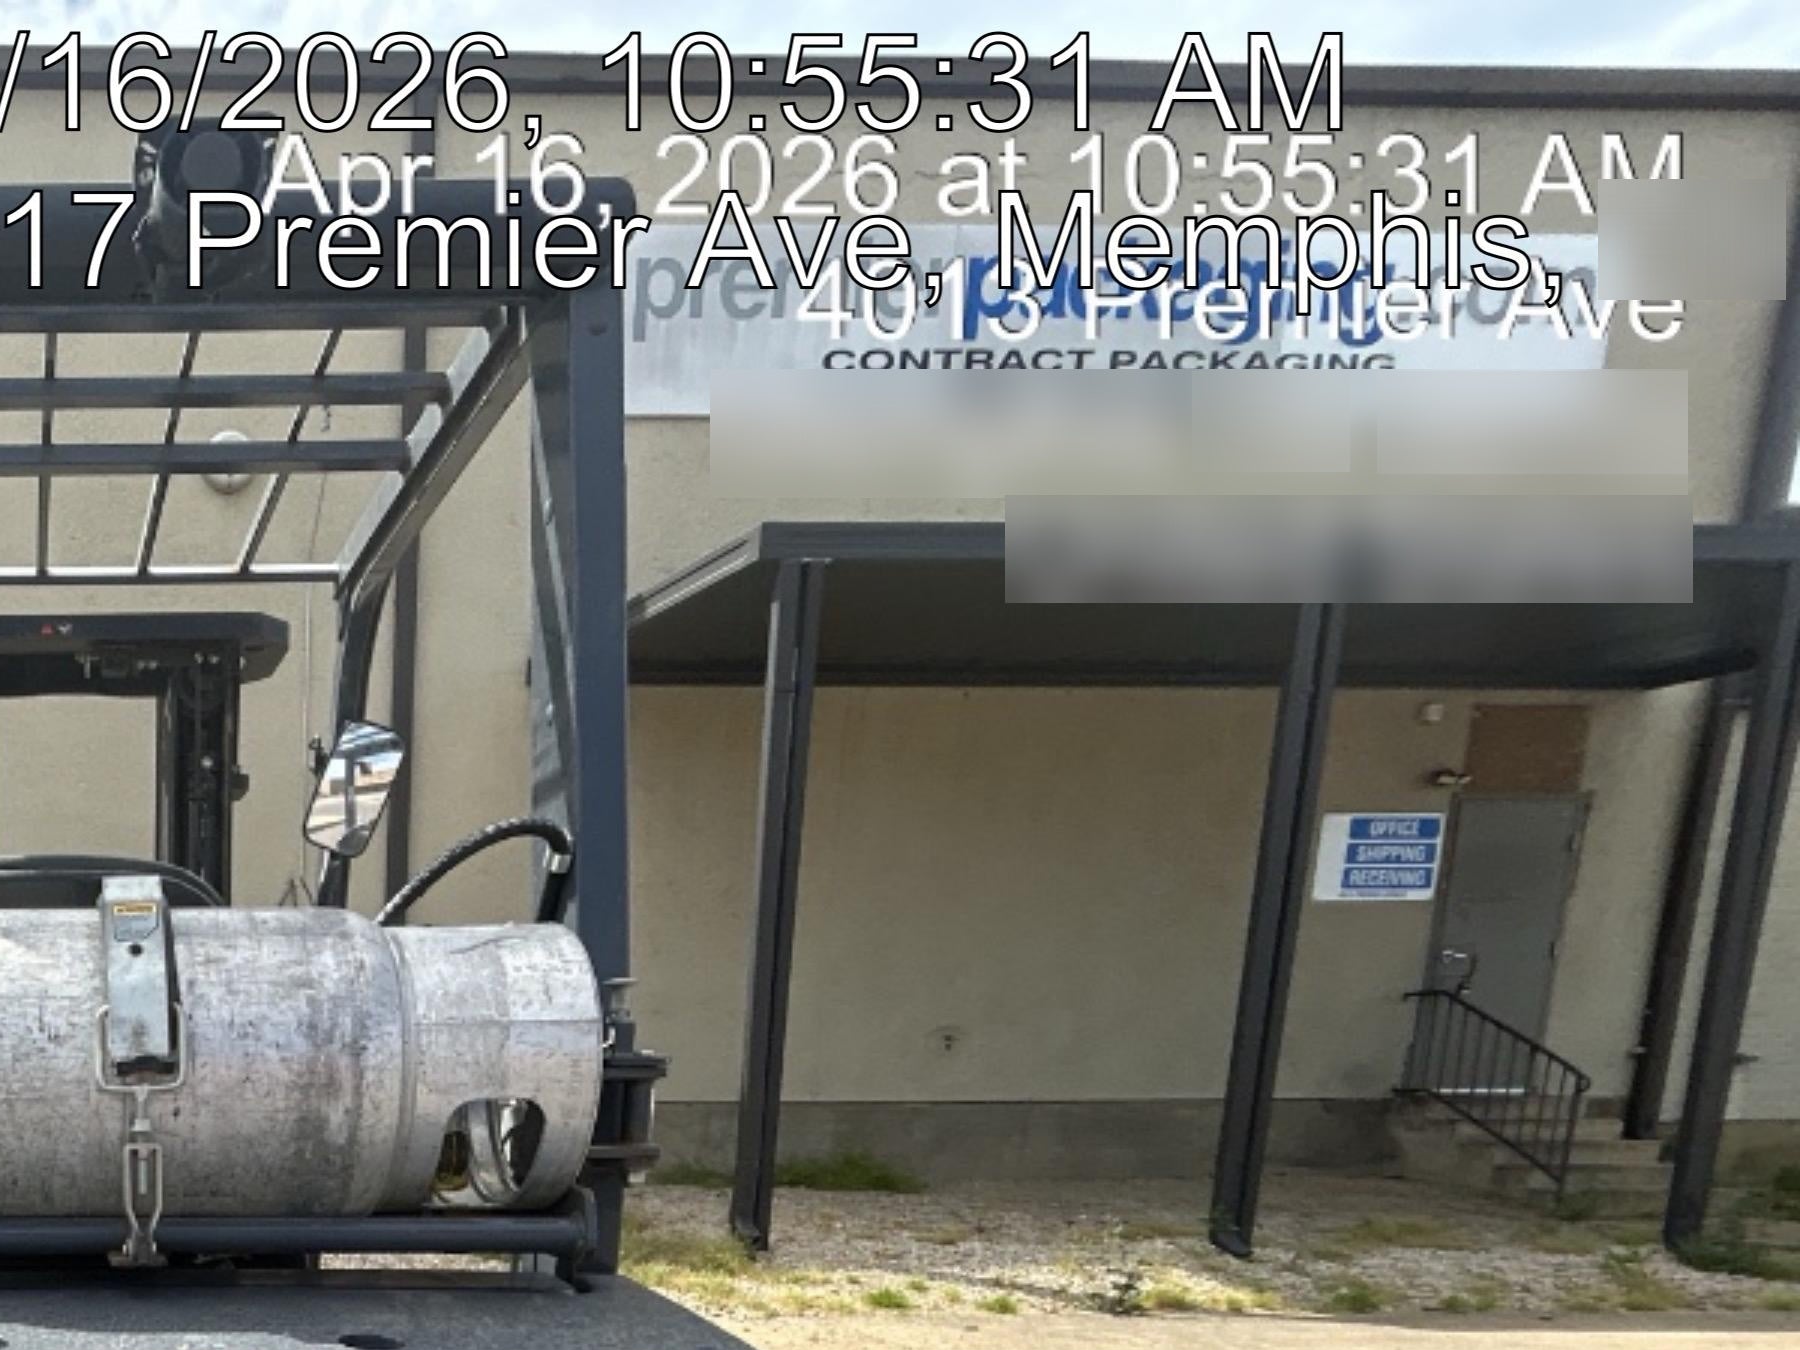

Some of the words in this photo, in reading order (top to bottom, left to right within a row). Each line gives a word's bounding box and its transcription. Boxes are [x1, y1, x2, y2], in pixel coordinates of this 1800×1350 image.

[821, 348, 1096, 369] CONTRACT
[1109, 349, 1396, 369] PACKAGING
[1369, 820, 1419, 836] OFFICE
[1355, 845, 1426, 862] SHIPPING
[1349, 869, 1426, 886] RECEIVING
